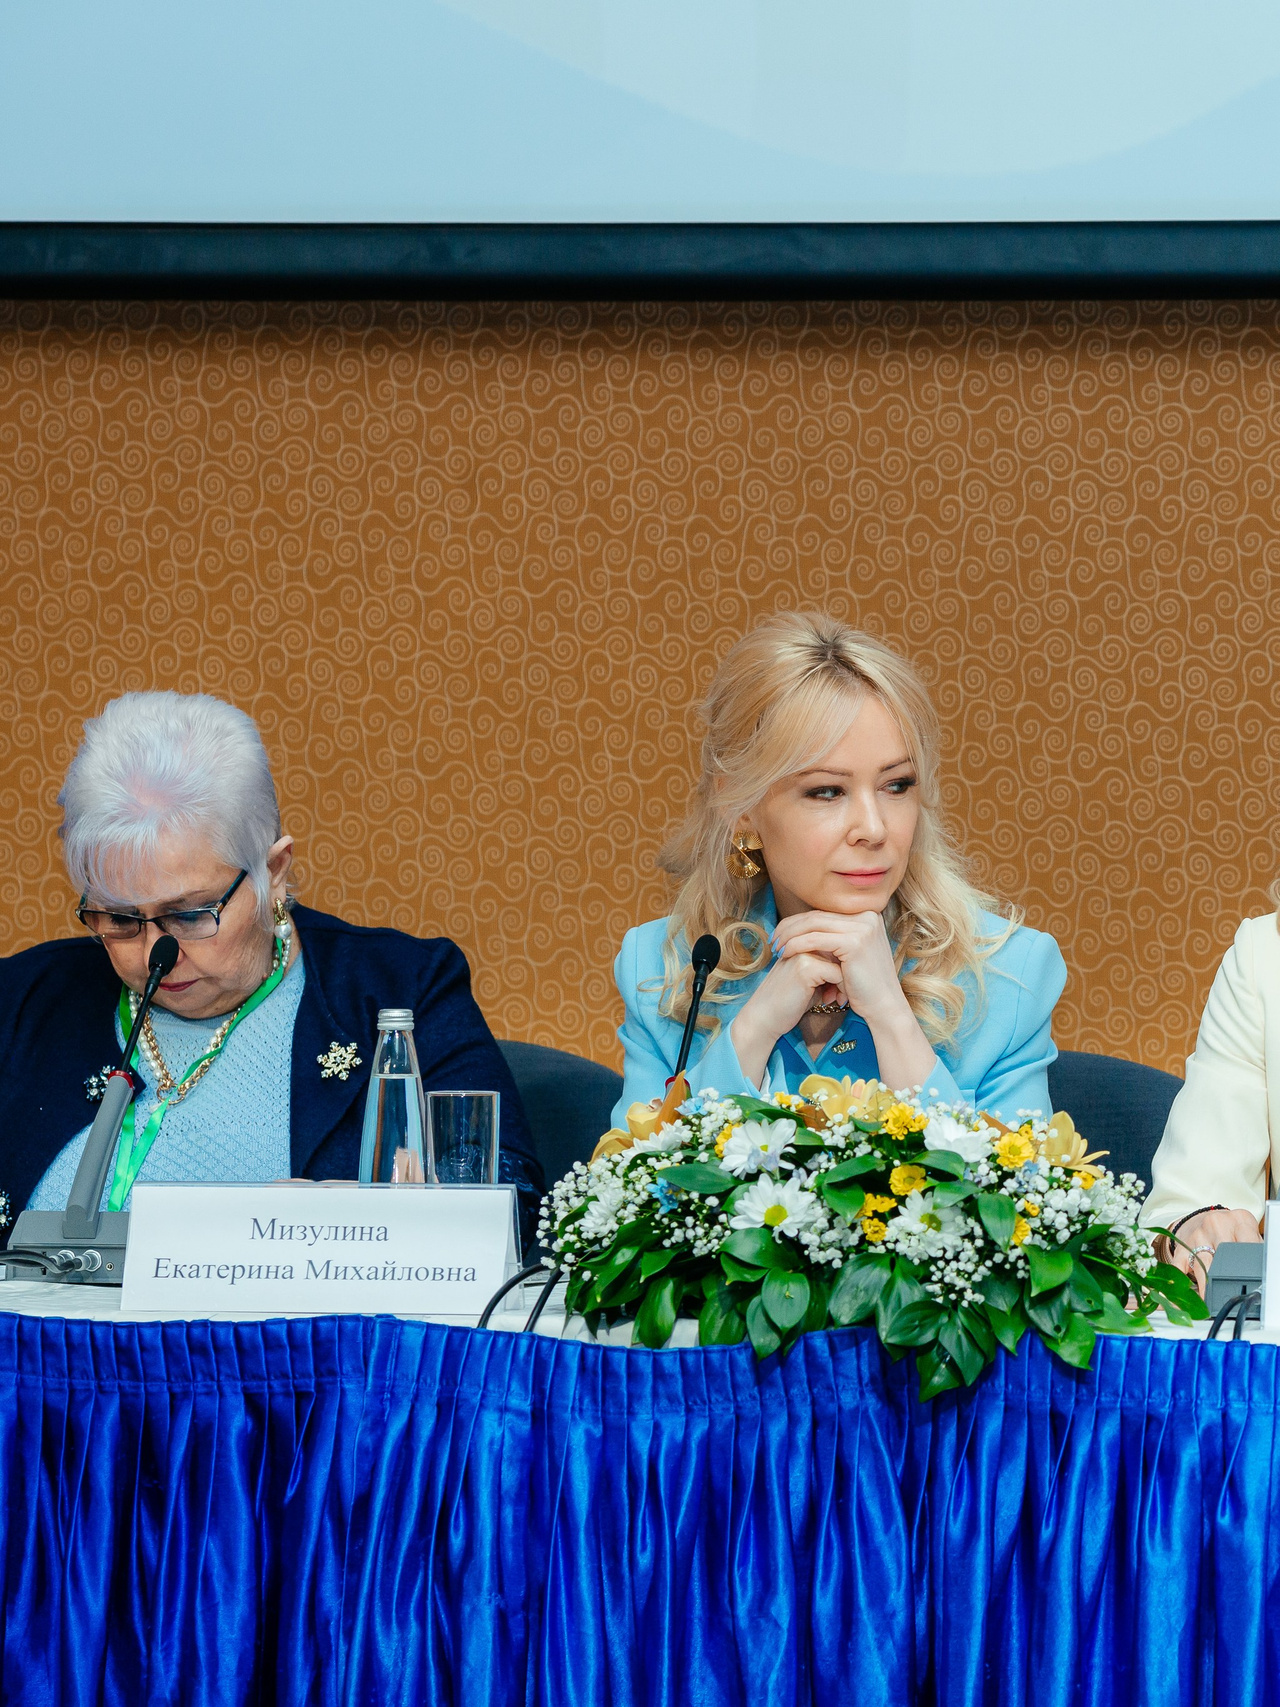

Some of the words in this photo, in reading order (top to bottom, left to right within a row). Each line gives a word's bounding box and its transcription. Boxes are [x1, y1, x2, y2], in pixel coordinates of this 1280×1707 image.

[250, 1217, 389, 1246] Мизулина
[152, 1257, 295, 1286] Екатерина
[304, 1258, 477, 1282] Михайловна
